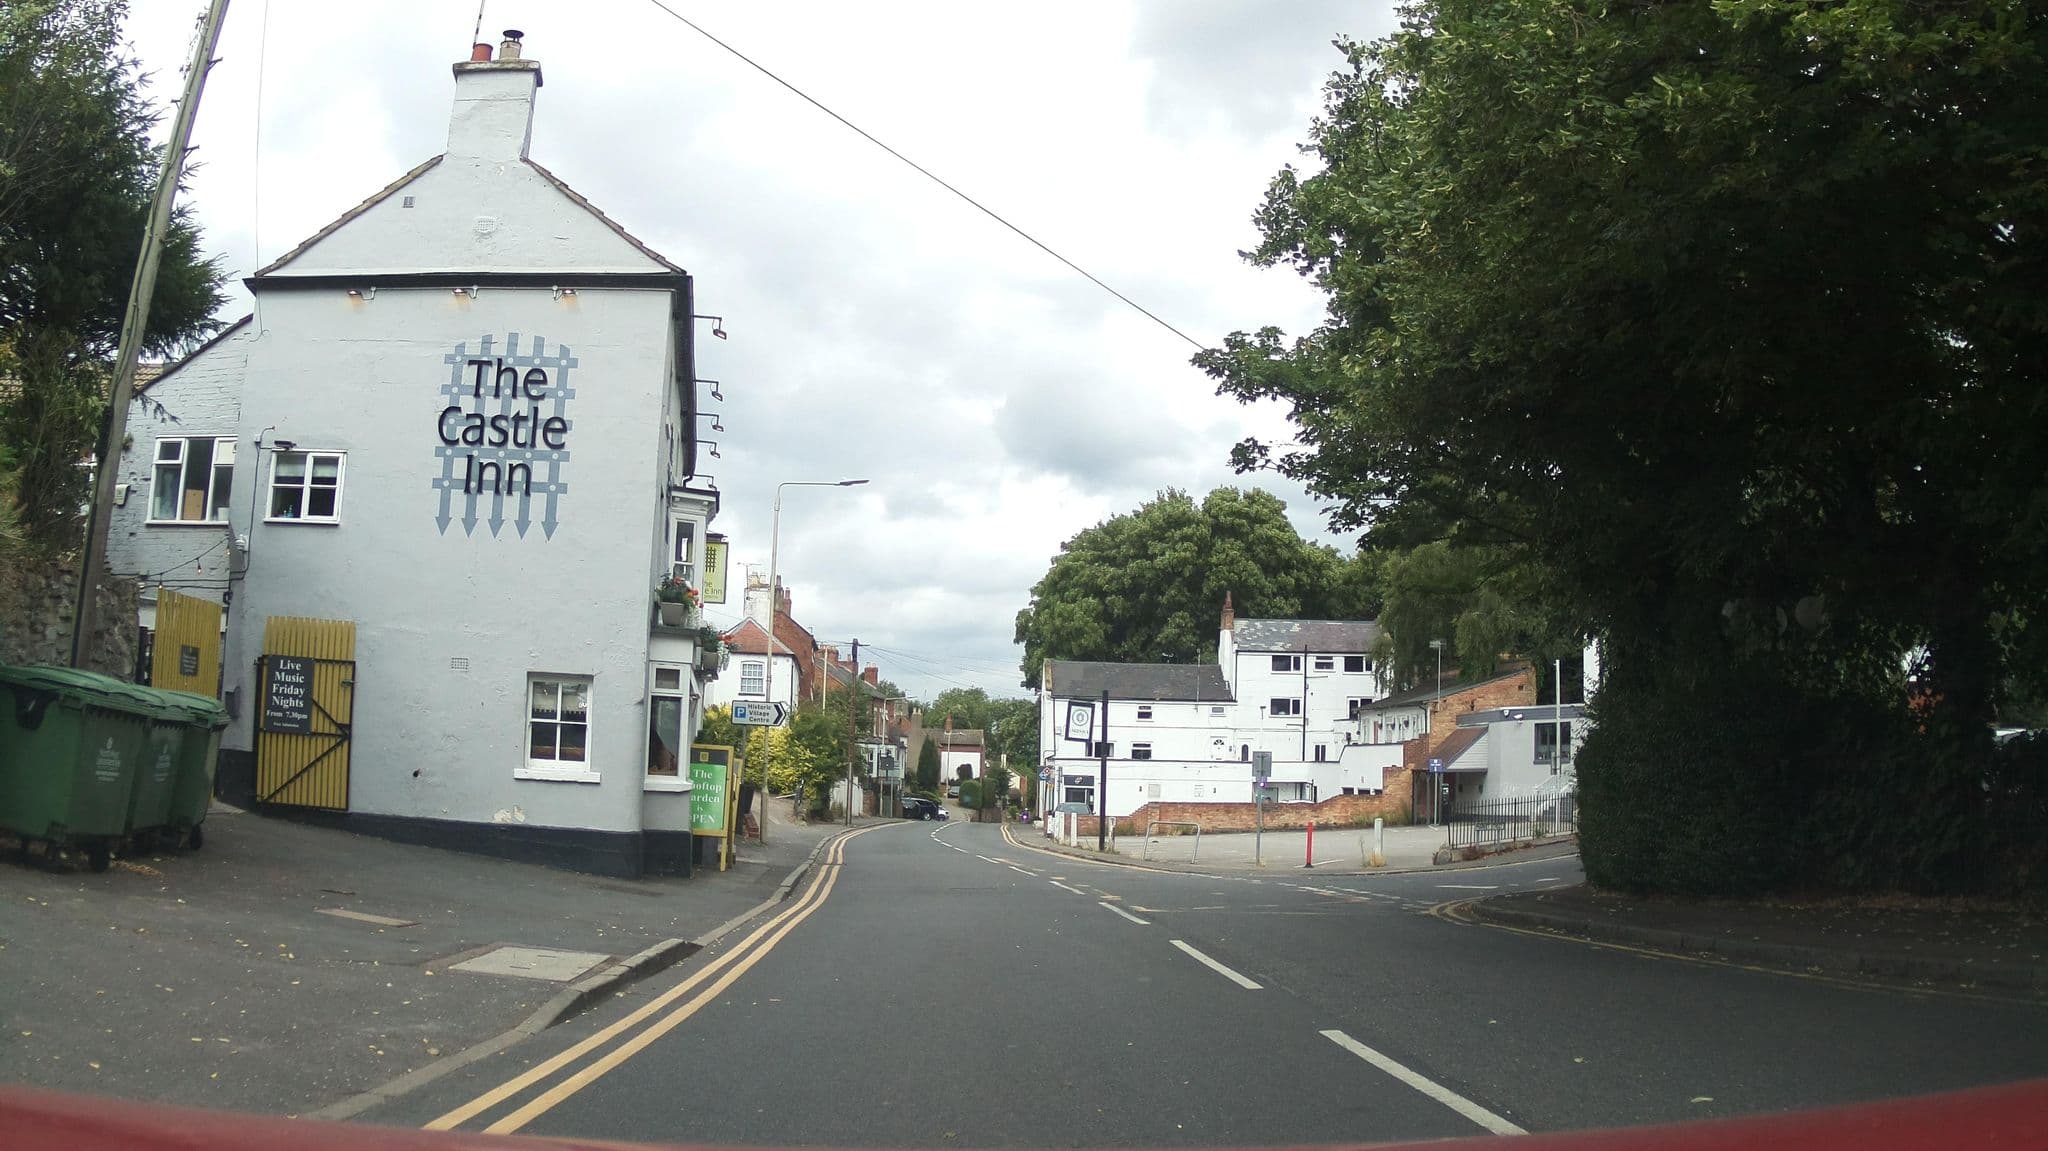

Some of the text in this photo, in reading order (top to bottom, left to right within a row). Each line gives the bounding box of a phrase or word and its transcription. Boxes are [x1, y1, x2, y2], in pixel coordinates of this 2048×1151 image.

[467, 357, 549, 401] The
[438, 406, 568, 450] Castle
[463, 454, 532, 497] Inn
[280, 659, 301, 670] Live
[275, 672, 304, 683] Music
[272, 684, 305, 698] Friday
[272, 696, 304, 709] Nights
[693, 769, 713, 779] The
[690, 793, 720, 803] arden
[692, 813, 716, 824] PEN
